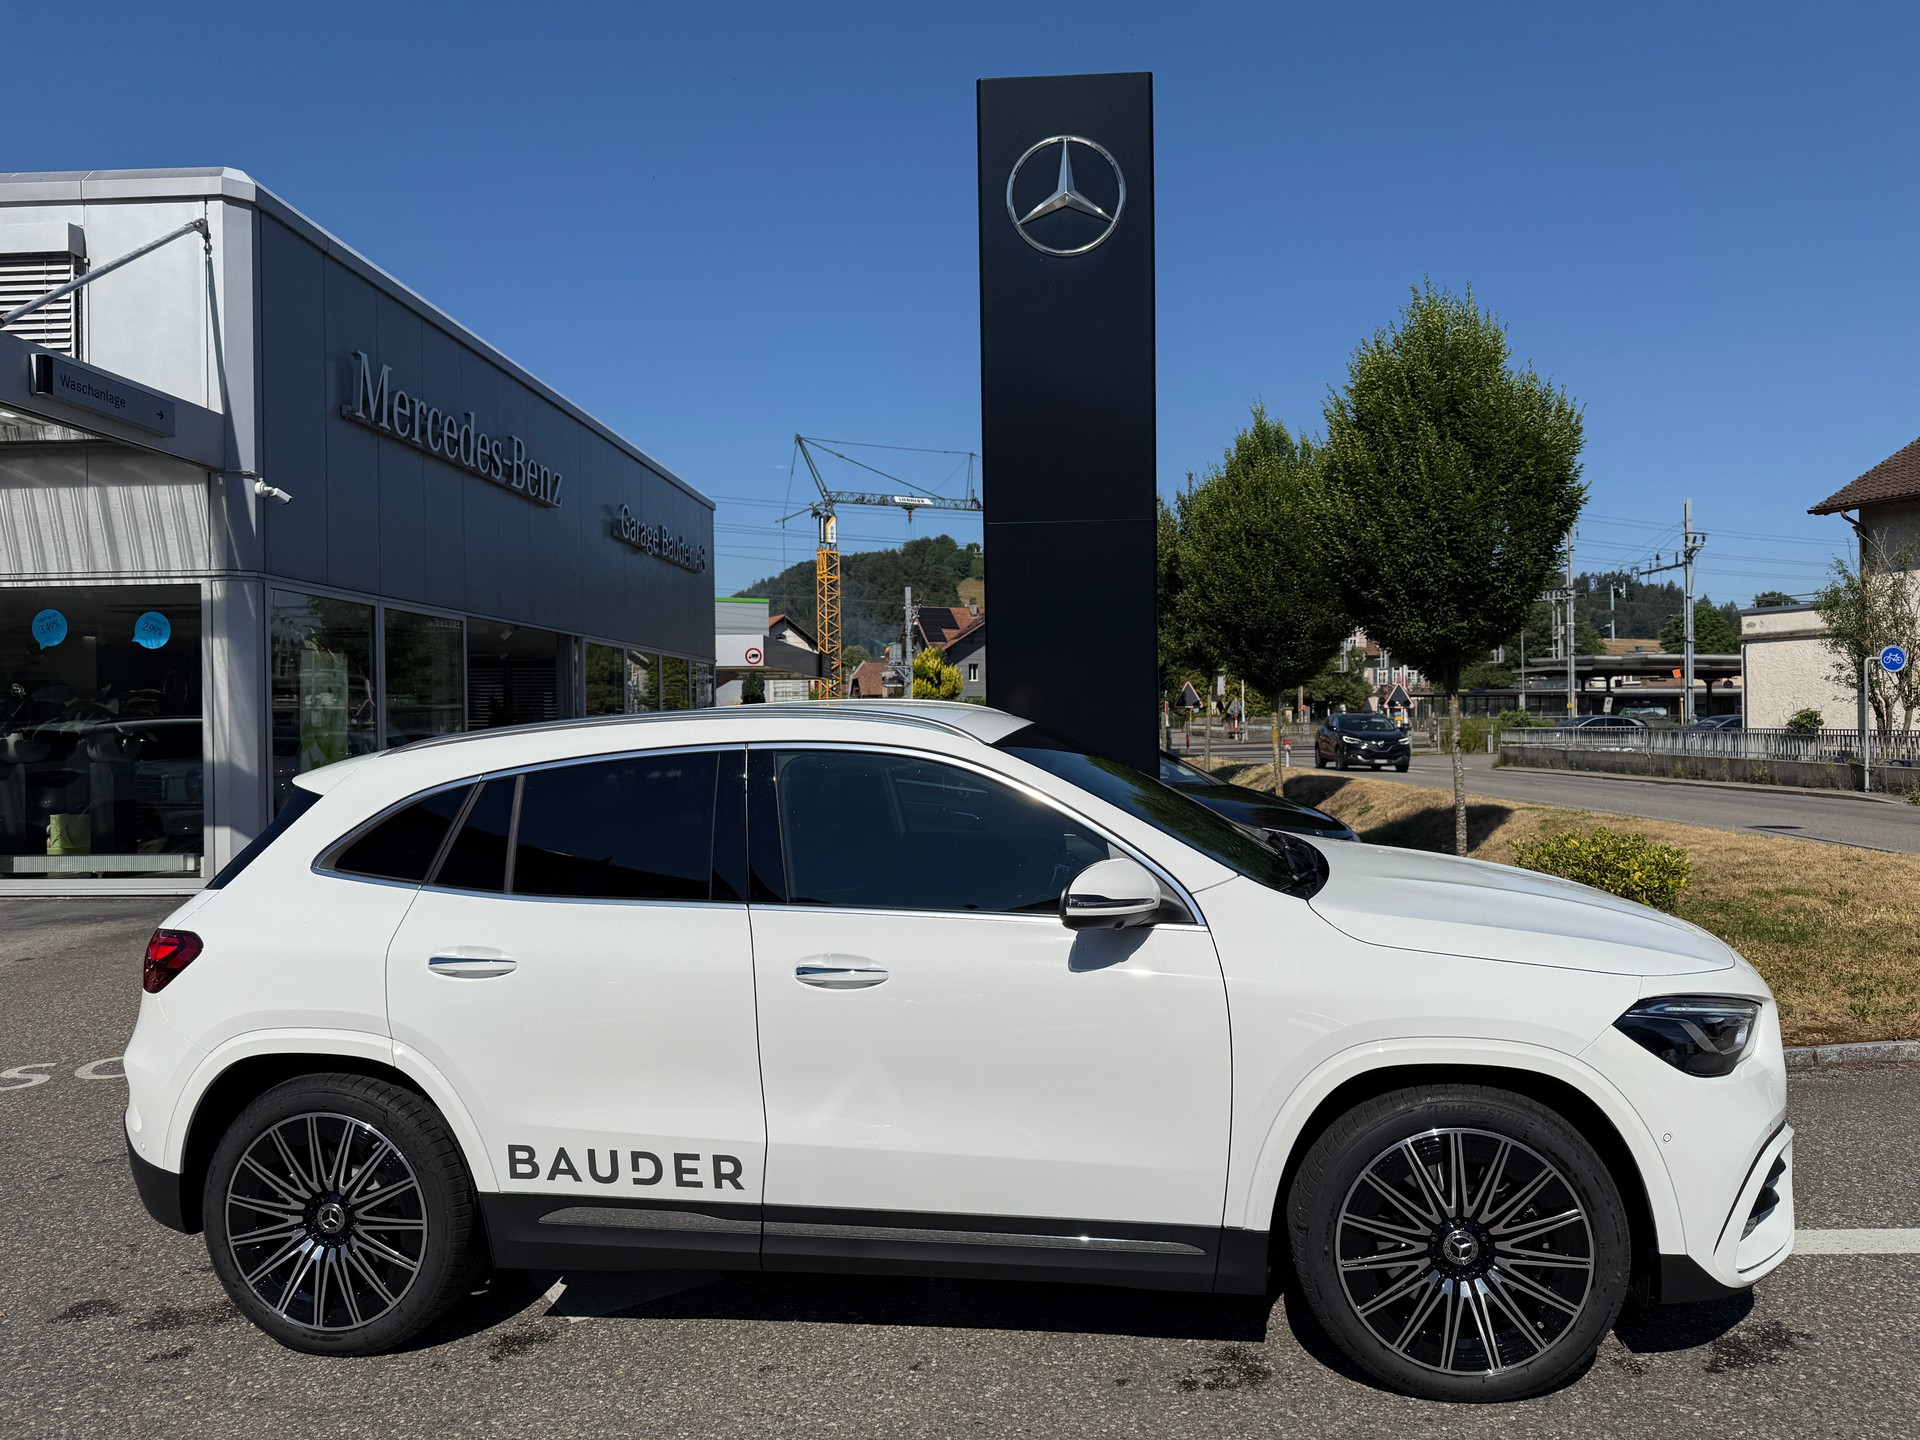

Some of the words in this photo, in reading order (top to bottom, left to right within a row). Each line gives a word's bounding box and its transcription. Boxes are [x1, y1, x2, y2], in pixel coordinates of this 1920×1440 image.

[60, 372, 126, 409] Waschanlage
[354, 349, 563, 508] Mercedes-Benz
[621, 504, 660, 556] Garage
[662, 525, 694, 569] Bauder
[1590, 578, 1596, 589] 5
[1632, 569, 1638, 581] 6
[507, 1144, 746, 1190] BAUDER
